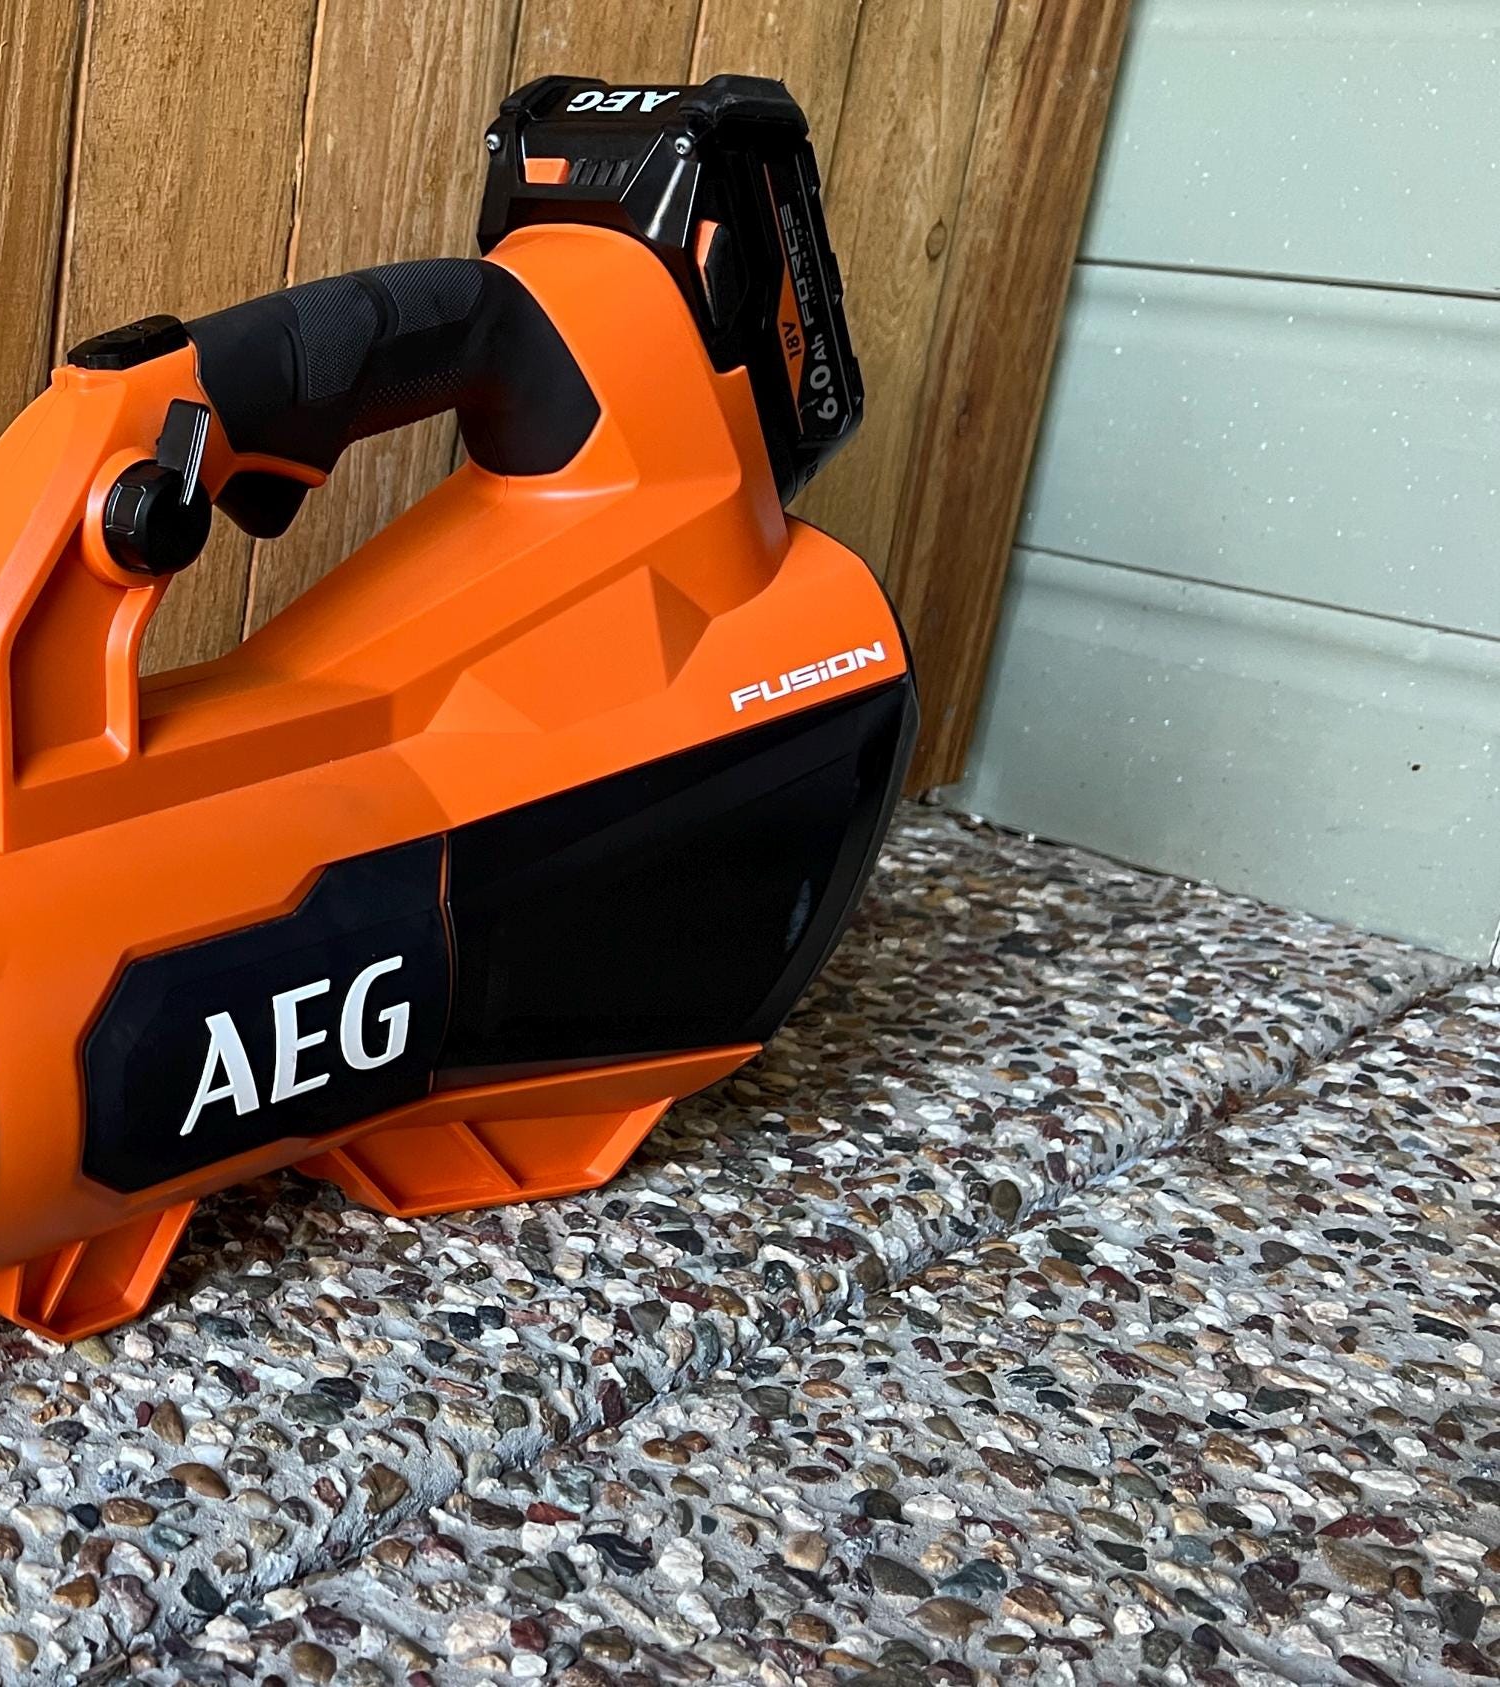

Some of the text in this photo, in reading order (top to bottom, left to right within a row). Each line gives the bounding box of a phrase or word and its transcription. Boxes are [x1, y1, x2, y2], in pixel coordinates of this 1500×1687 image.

[566, 90, 680, 113] AEG
[779, 203, 815, 327] FORCE
[781, 321, 801, 361] 18V
[179, 955, 411, 1137] AEG
